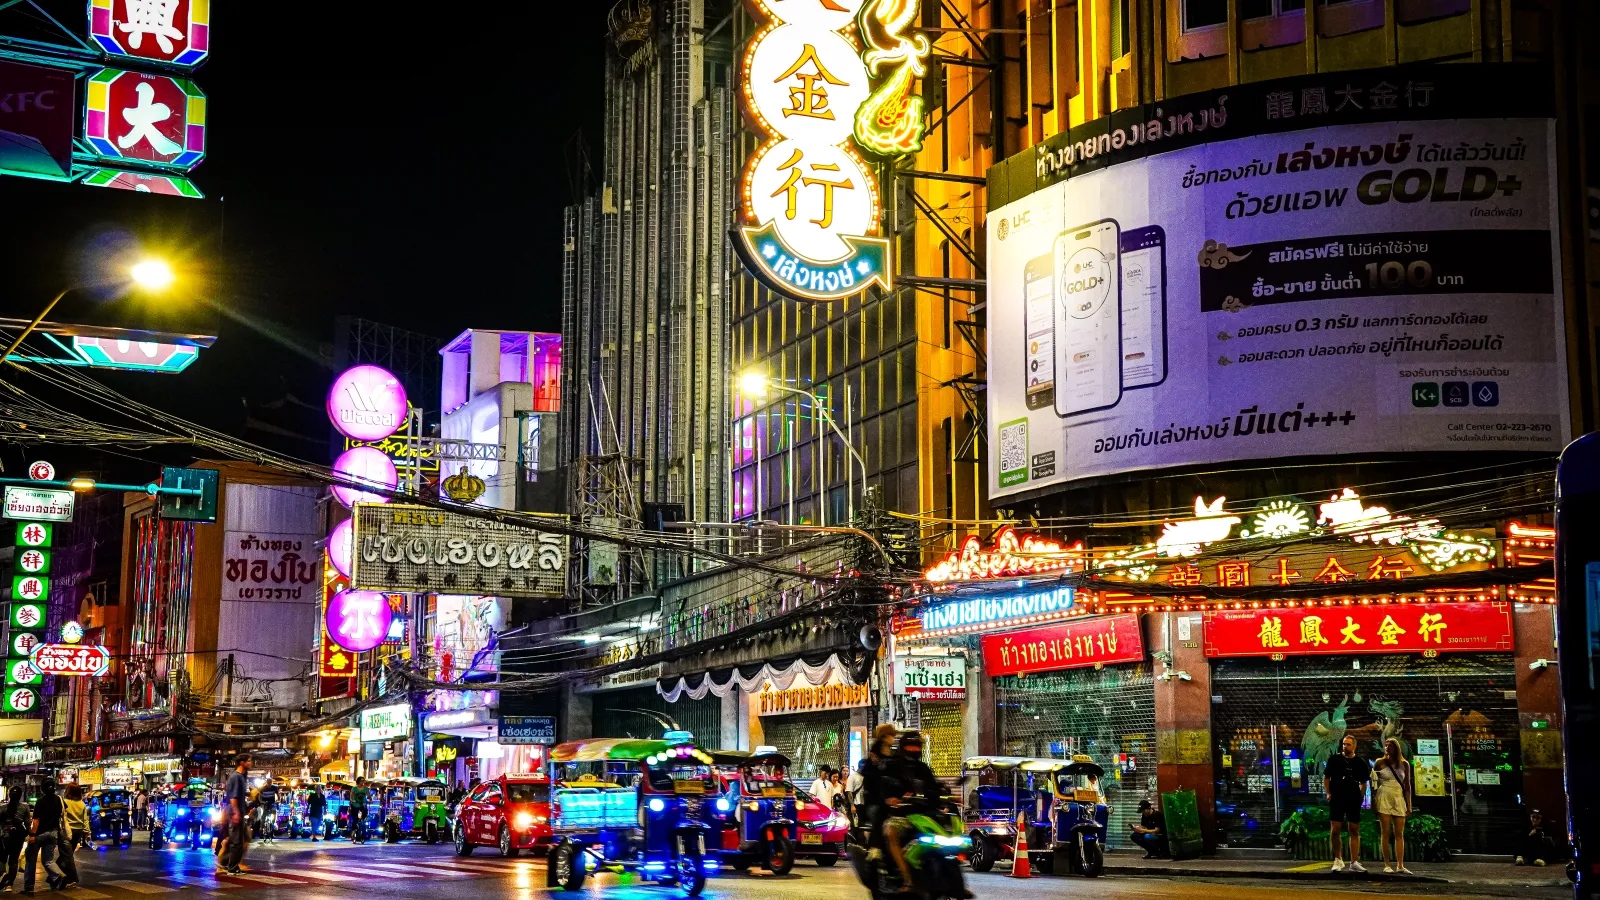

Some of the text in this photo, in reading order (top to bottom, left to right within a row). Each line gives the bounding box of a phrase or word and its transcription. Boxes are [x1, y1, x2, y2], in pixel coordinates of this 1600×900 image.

[1266, 80, 1437, 120] 龍鳳大金行
[1182, 134, 1526, 189] ซื้อทองกับ เล่งหงษ์ ได้แล้ววันนี้!
[1226, 166, 1522, 220] ด้วยแอพ GOLD+
[1268, 241, 1429, 264] สมัครฟรี! ไม่มีค่าใช้จ่าย
[773, 254, 855, 292] เล่งหงษ์
[1067, 276, 1104, 294] GOLD+
[1252, 260, 1464, 298] ซื้อ-ขาย ขั้นต่ำ 100 บาท
[1238, 312, 1488, 338] ออมครบ 0.3 กรัม แลกการ์ดทองได้เลย
[1238, 333, 1504, 364] ออมสะดวก ปลอดภัย อยู่ที่ไหนก็ออมได้
[1414, 389, 1436, 401] K+
[340, 409, 396, 427] Wacoal
[1447, 423, 1464, 431] Call
[1465, 423, 1494, 431] Center
[393, 510, 445, 526] ทอง
[240, 534, 302, 551] ห้างทอง
[238, 586, 302, 599] เยาวราช
[1257, 612, 1448, 648] 龍鳳大金行
[1000, 620, 1118, 667] ห้างทองเล่งหงษ์
[904, 667, 964, 687] วเซ่งเฮง
